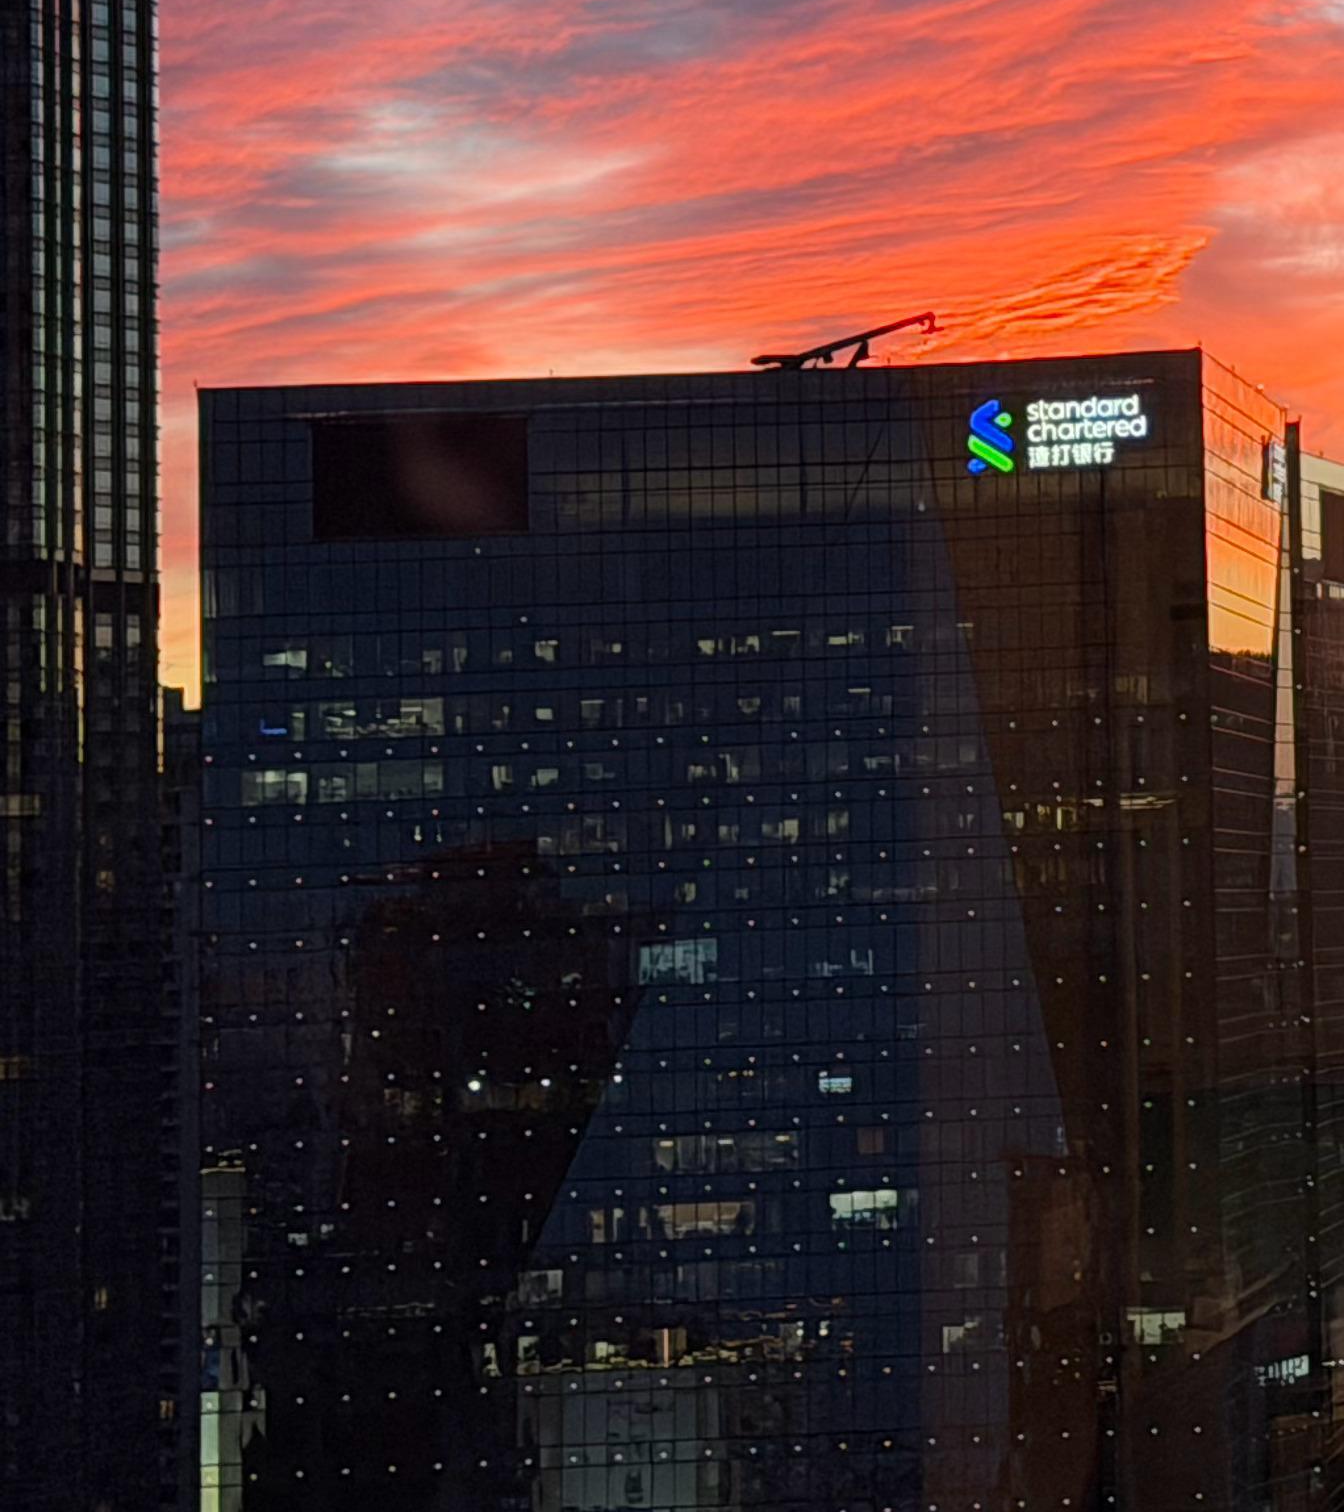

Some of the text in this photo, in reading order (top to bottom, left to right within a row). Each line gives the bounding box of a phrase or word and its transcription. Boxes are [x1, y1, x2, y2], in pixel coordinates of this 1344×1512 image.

[1026, 394, 1139, 422] standard
[1026, 415, 1147, 443] chartered
[1027, 441, 1114, 469] 渣打银行
